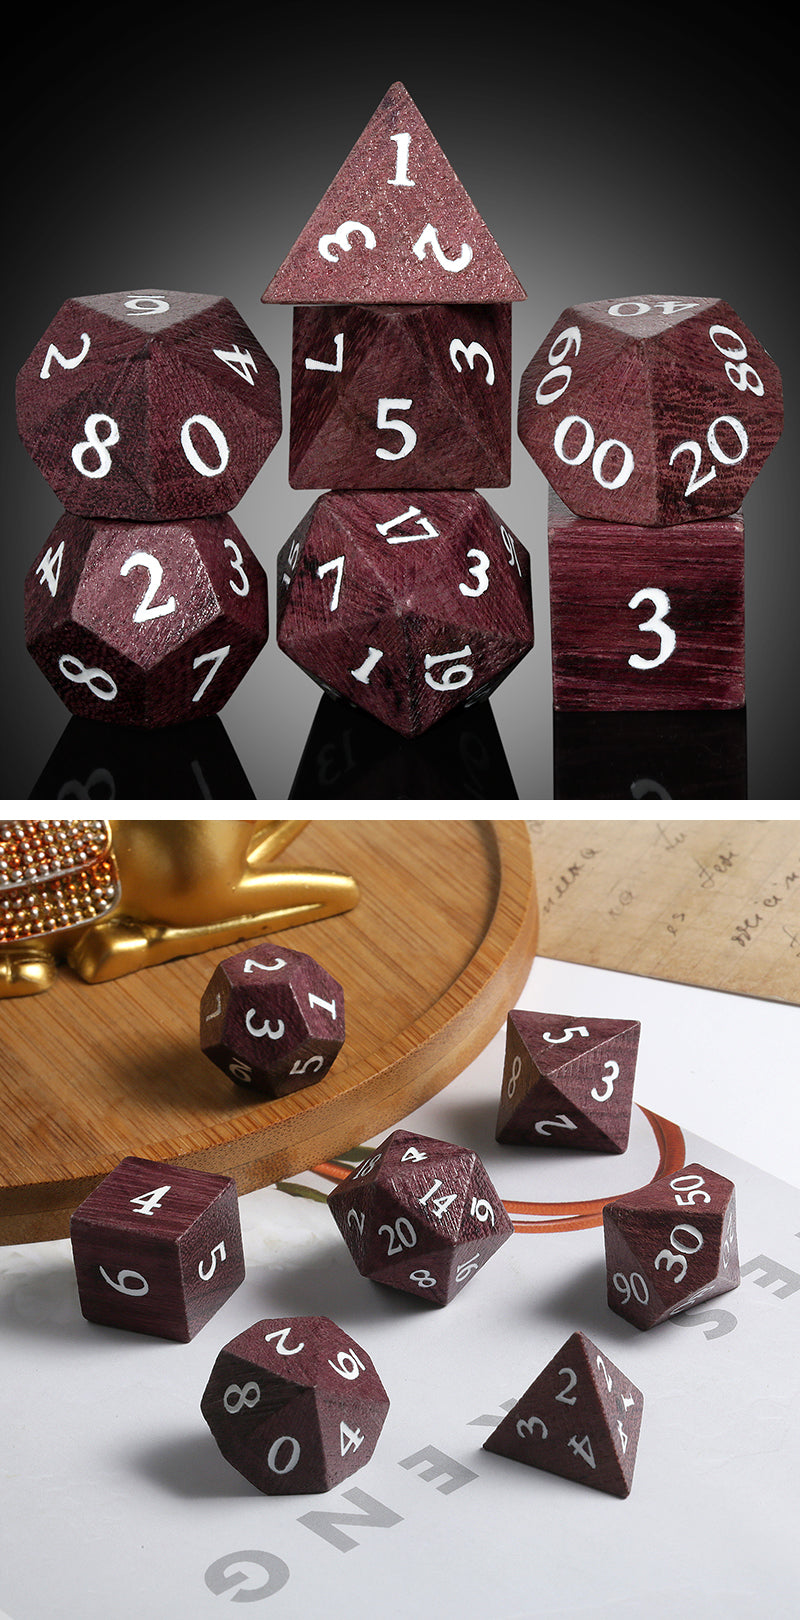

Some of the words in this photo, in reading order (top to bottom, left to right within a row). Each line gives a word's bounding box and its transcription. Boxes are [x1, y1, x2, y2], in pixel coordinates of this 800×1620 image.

[387, 132, 415, 187] 1
[318, 220, 376, 263] 3
[412, 222, 473, 273] 2
[608, 301, 700, 316] 40
[40, 333, 91, 379] 2
[213, 343, 258, 386] 4
[305, 333, 344, 373] 7
[449, 338, 494, 386] 3
[536, 326, 581, 405] 60
[709, 324, 764, 397] 80
[71, 413, 119, 479] 8
[180, 414, 230, 477] 0
[375, 398, 417, 461] 5
[554, 415, 634, 490] 00
[669, 415, 749, 497] 20
[375, 505, 440, 545] 17
[36, 541, 65, 597] 4
[120, 552, 176, 623] 2
[223, 538, 250, 597] 3
[317, 555, 345, 611] 7
[458, 548, 490, 597] 3
[627, 587, 677, 670] 3
[58, 653, 118, 700] 8
[192, 645, 230, 701] 7
[351, 646, 384, 684] 1
[243, 957, 288, 974] 2
[245, 1007, 286, 1041] 3
[308, 992, 337, 1021] 1
[542, 1025, 590, 1044] 5
[289, 1055, 325, 1076] 5
[507, 1055, 522, 1100] 8
[590, 1060, 620, 1103] 3
[534, 1114, 578, 1136] 2
[351, 1152, 383, 1181] 18
[401, 1146, 429, 1163] 4
[129, 1185, 172, 1217] 4
[418, 1178, 458, 1219] 14
[669, 1174, 712, 1207] 50
[347, 1208, 367, 1236] 2
[378, 1217, 417, 1256] 20
[198, 1240, 227, 1281] 5
[654, 1223, 703, 1283] 30
[409, 1269, 438, 1289] 8
[612, 1272, 650, 1306] 90
[264, 1327, 305, 1356] 2
[223, 1381, 261, 1414] 8
[555, 1367, 578, 1406] 2
[339, 1420, 365, 1457] 4
[516, 1416, 549, 1440] 3
[267, 1436, 301, 1475] 0
[567, 1434, 597, 1470] 4
